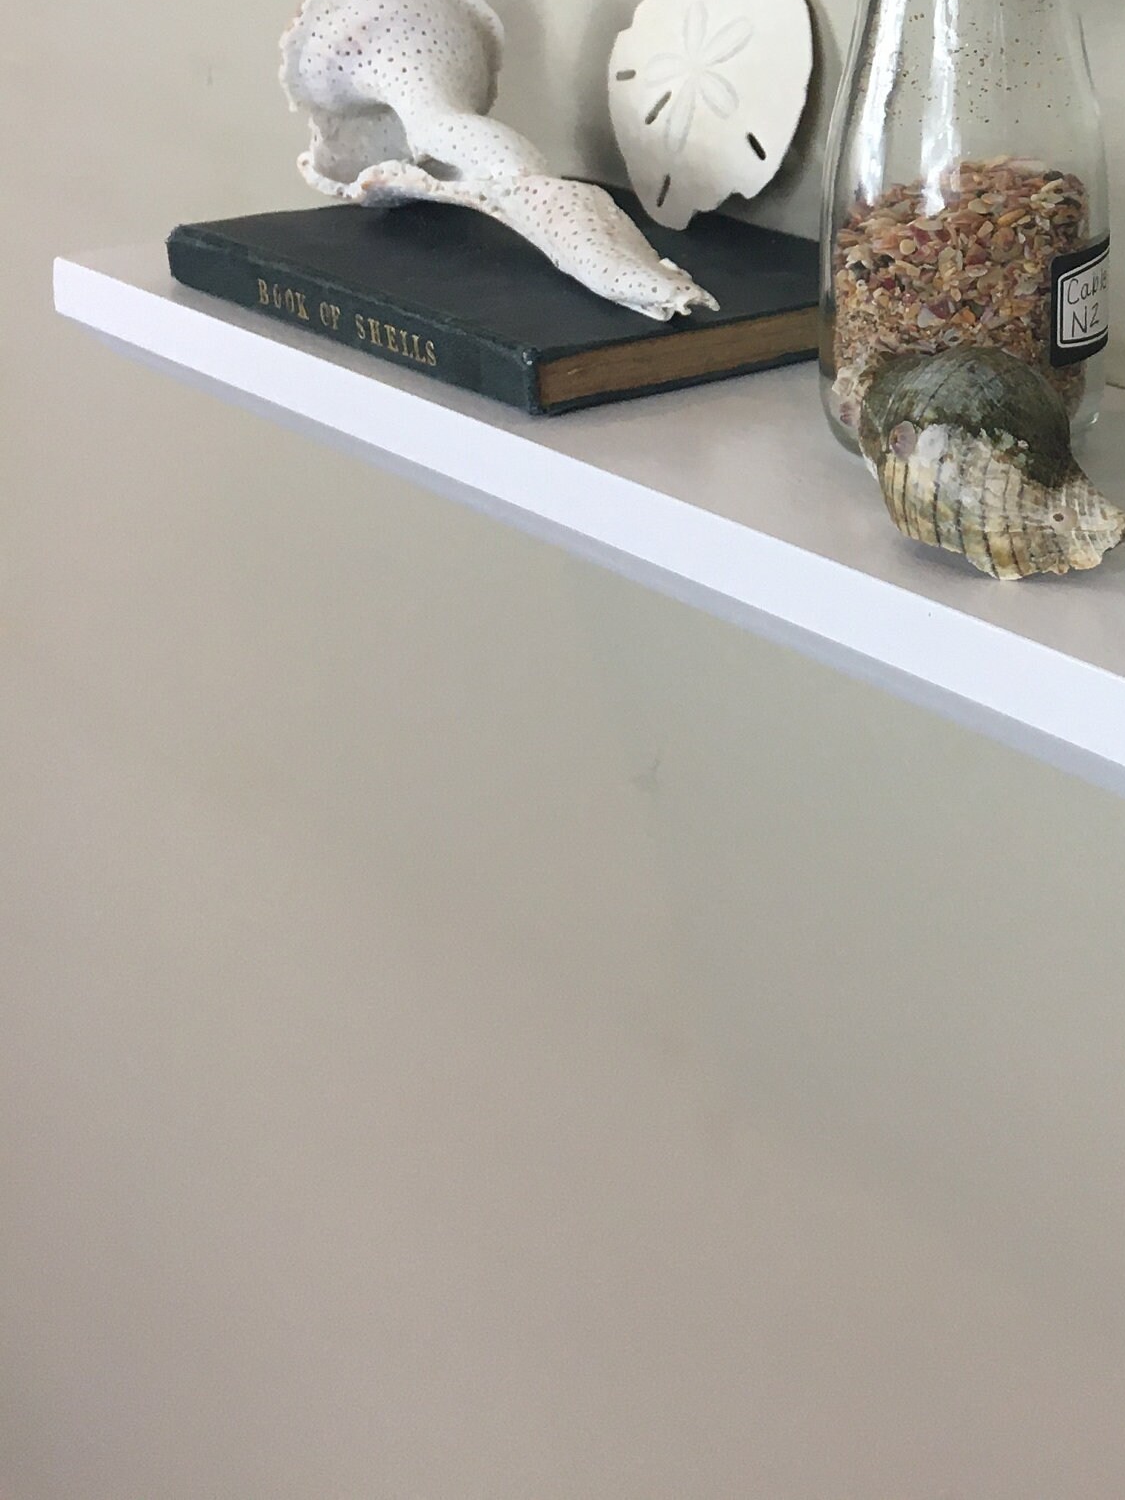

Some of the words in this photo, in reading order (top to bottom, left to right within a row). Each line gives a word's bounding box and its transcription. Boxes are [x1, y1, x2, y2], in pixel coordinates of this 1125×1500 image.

[257, 278, 309, 321] BOOK
[318, 301, 341, 330] OF
[355, 313, 437, 366] SHELLS
